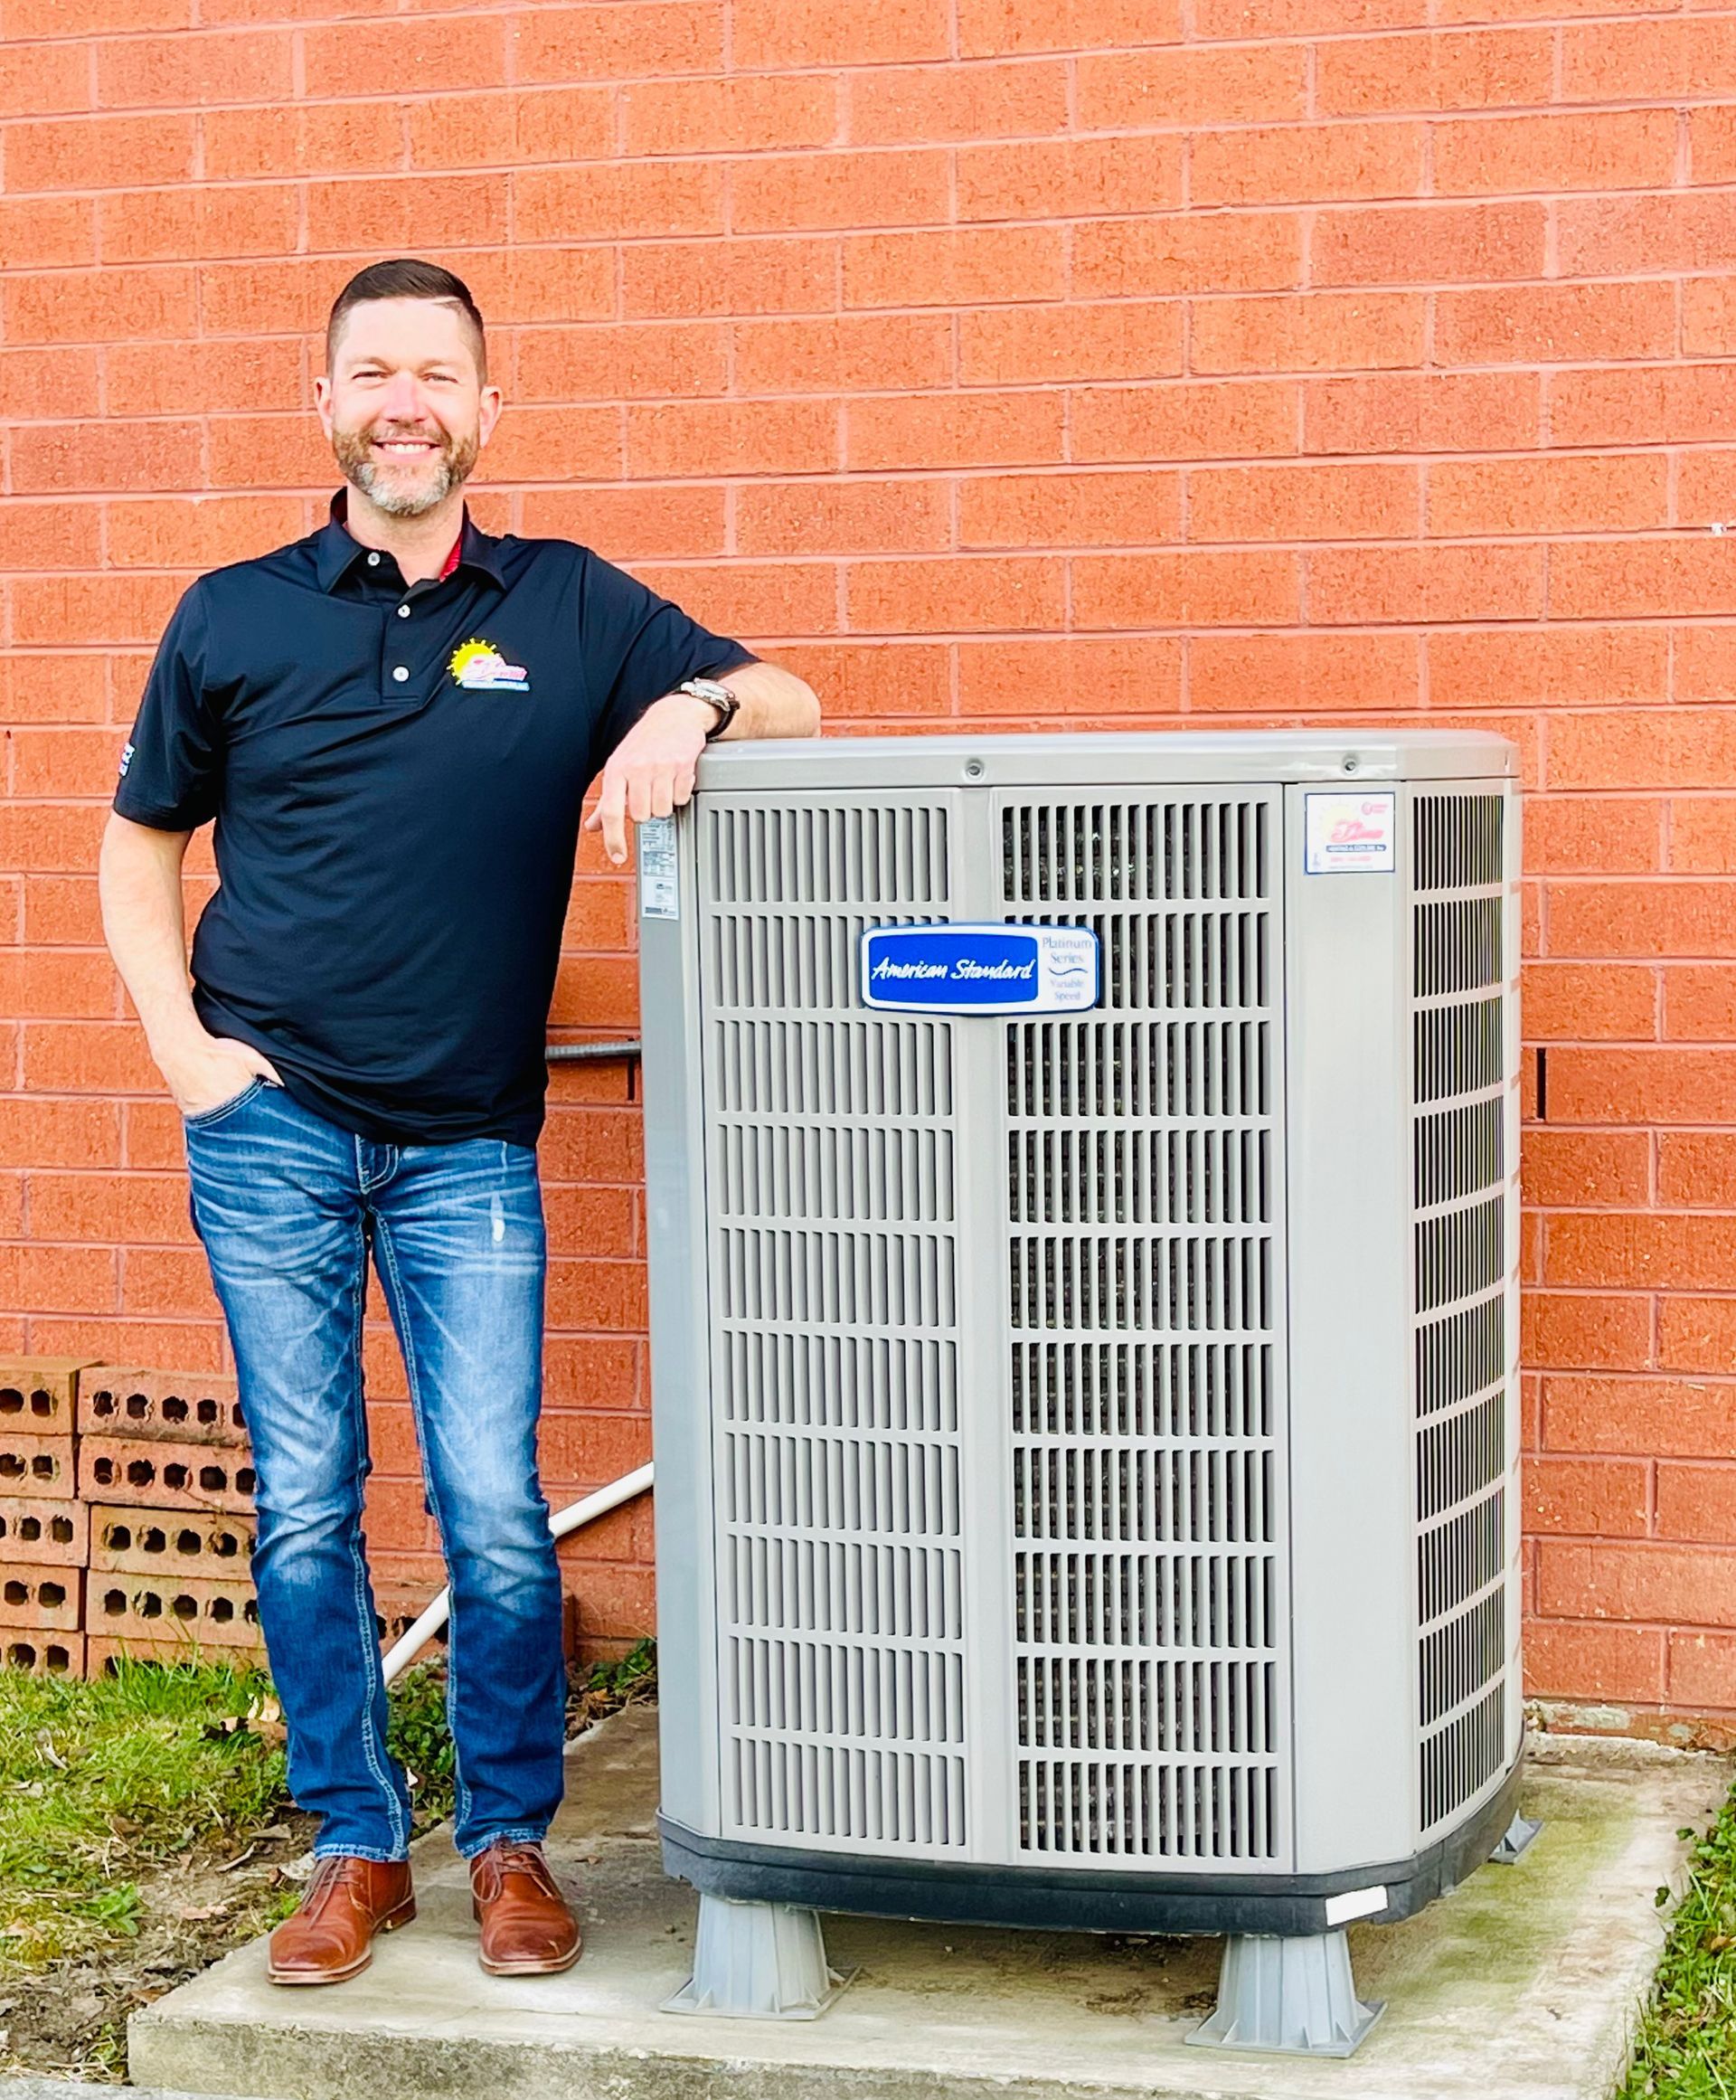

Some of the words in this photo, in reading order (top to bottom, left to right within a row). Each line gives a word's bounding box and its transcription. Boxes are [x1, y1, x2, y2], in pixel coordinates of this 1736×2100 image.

[1043, 937, 1092, 949] Platinum
[1050, 951, 1084, 963] Series
[872, 957, 948, 979] American
[950, 959, 1035, 979] Standard
